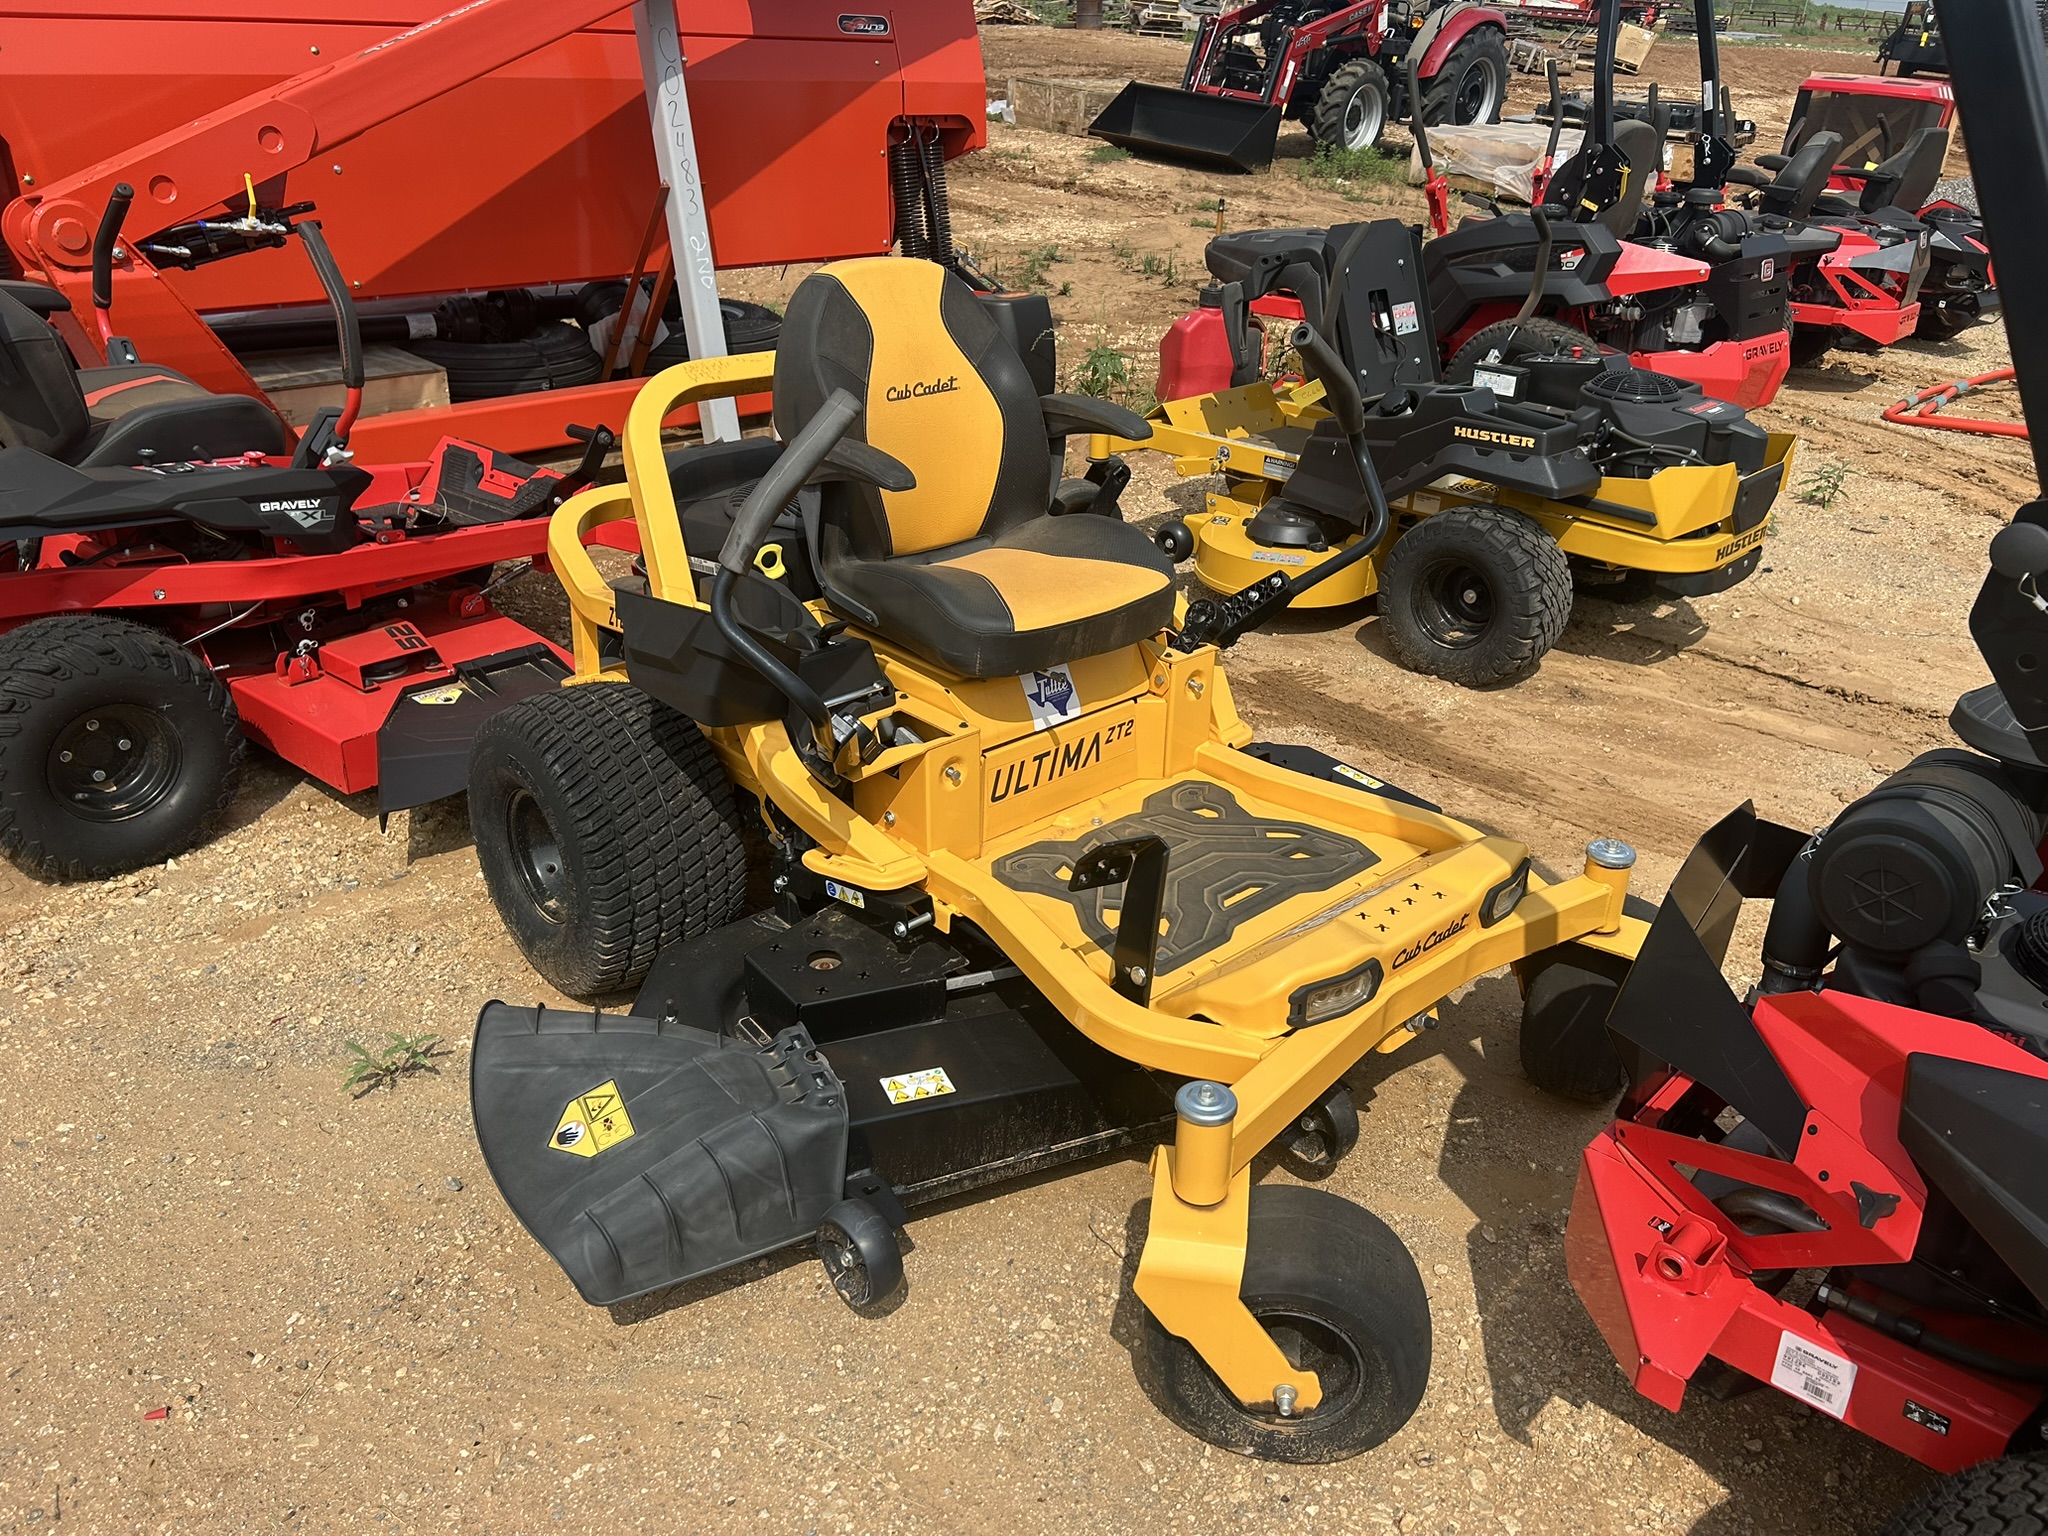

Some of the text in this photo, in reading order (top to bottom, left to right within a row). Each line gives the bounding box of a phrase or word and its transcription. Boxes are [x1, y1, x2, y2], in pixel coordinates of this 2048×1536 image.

[1745, 340, 1784, 360] GRAVELY
[886, 376, 958, 402] Cub Cadet
[1454, 426, 1536, 448] HUSTLER
[260, 499, 321, 512] GRAVELY
[1715, 525, 1768, 562] HUSTLER
[384, 623, 429, 651] 52
[990, 719, 1134, 804] ULTIMA ZT2
[1392, 913, 1470, 970] Cub Cadet
[1803, 1350, 1838, 1370] GRAVELY
